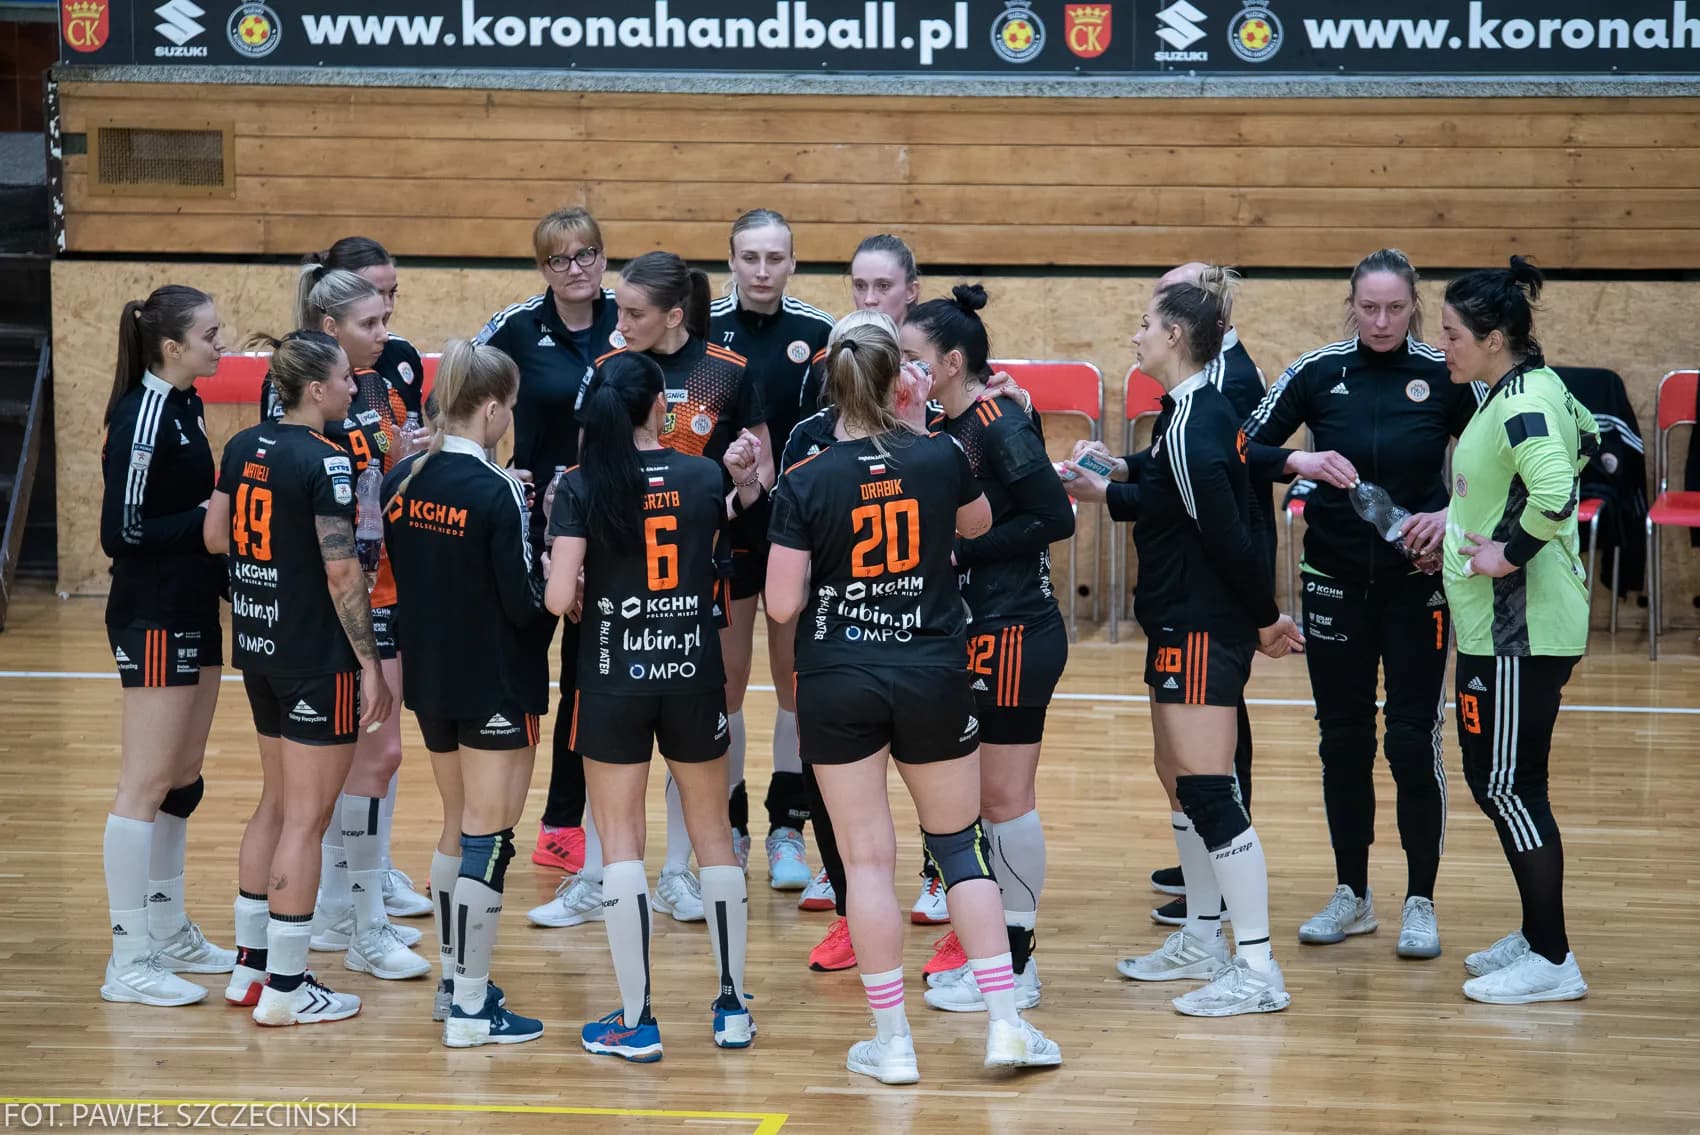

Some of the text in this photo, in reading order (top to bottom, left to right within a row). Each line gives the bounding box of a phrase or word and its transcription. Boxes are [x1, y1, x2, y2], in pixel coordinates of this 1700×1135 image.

[67, 19, 101, 46] CK
[301, 1, 969, 65] www.koronahandball.pl
[1071, 24, 1104, 51] CK
[154, 46, 208, 57] SUZUKI
[1154, 51, 1208, 61] SUZUKI
[723, 331, 735, 342] 77
[348, 429, 372, 470] 9
[860, 479, 903, 501] DRABIK
[232, 483, 272, 561] 49
[409, 499, 468, 528] KGHM
[851, 498, 920, 578] 20
[644, 515, 679, 591] 6
[242, 563, 278, 581] KGHM
[646, 595, 698, 613] KGHM
[1316, 585, 1344, 596] KGHM
[233, 591, 279, 629] lubin.pl
[837, 600, 922, 631] lubin.pl
[623, 623, 701, 656] lubin.pl
[863, 628, 912, 643] MPO
[1432, 610, 1444, 650] 1
[246, 635, 275, 655] MPO
[599, 646, 611, 676] PATER
[648, 662, 697, 680] MPO
